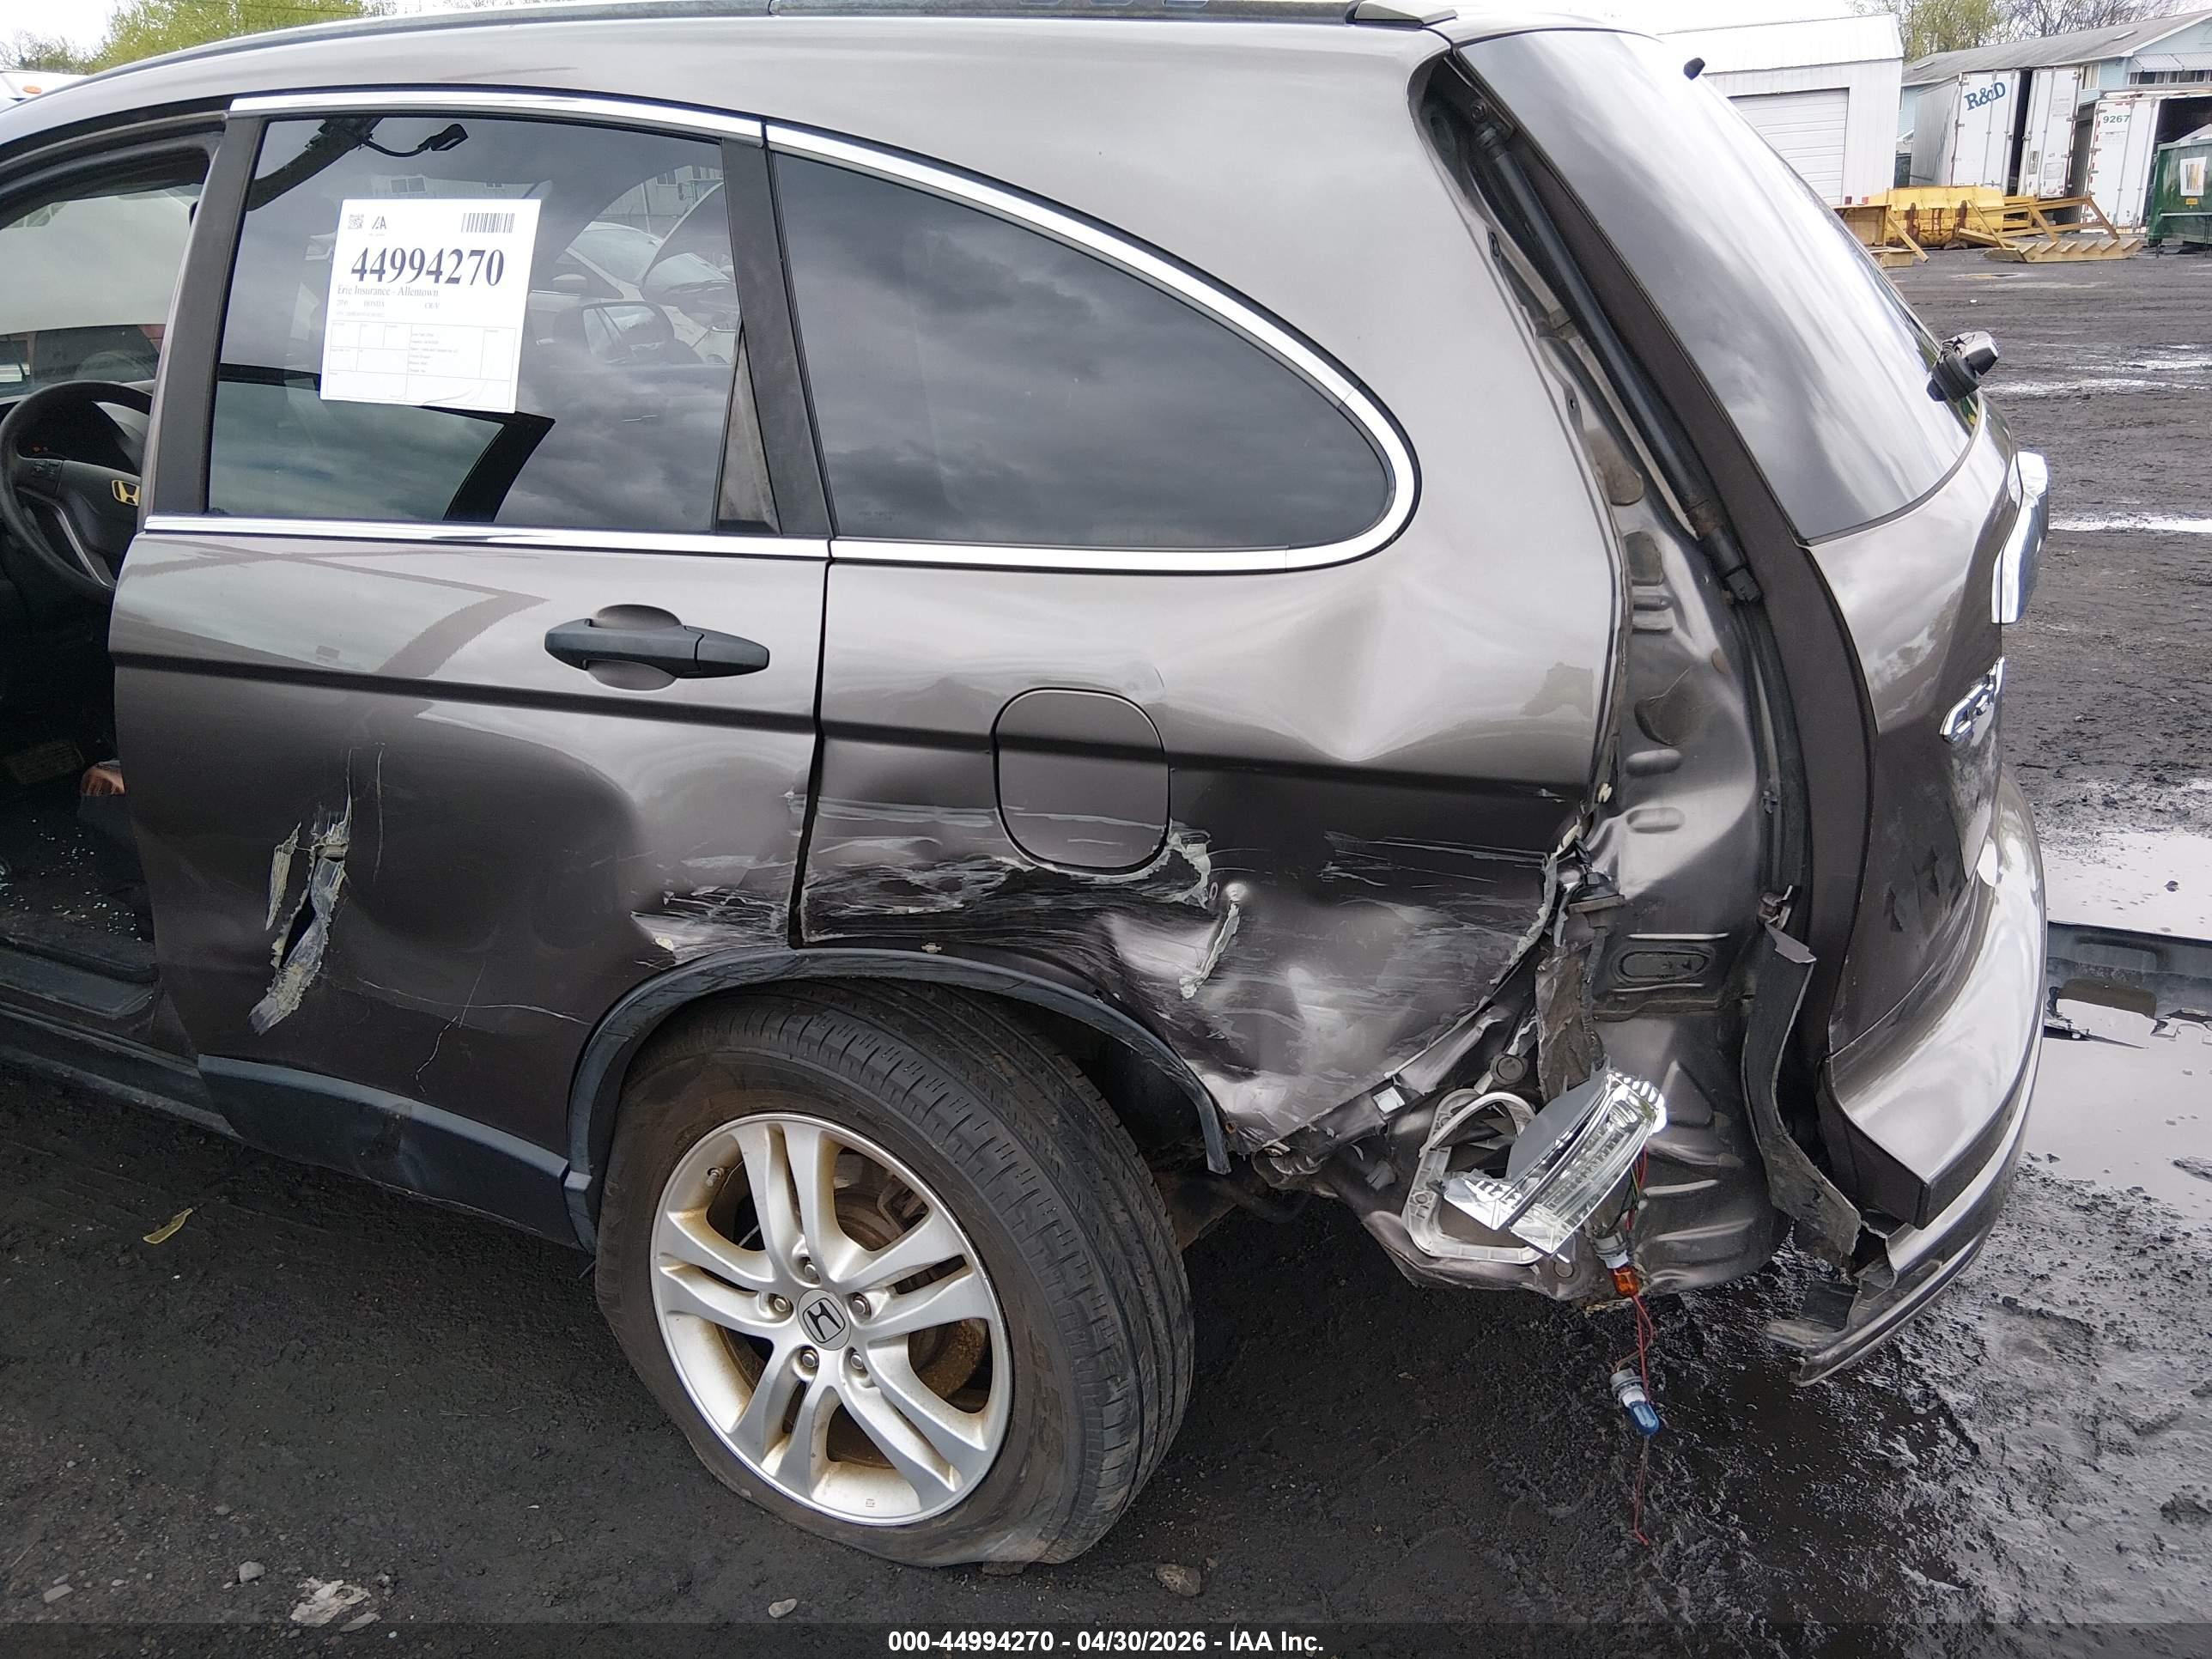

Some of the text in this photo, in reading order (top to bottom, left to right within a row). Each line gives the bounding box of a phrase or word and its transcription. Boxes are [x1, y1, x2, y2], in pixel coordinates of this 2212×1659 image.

[1964, 82, 2006, 111] R&D
[2103, 114, 2130, 124] 9267
[350, 246, 505, 287] 44994270
[337, 285, 353, 295] Erie
[355, 285, 391, 296] Insurance
[397, 286, 439, 297] Allentown
